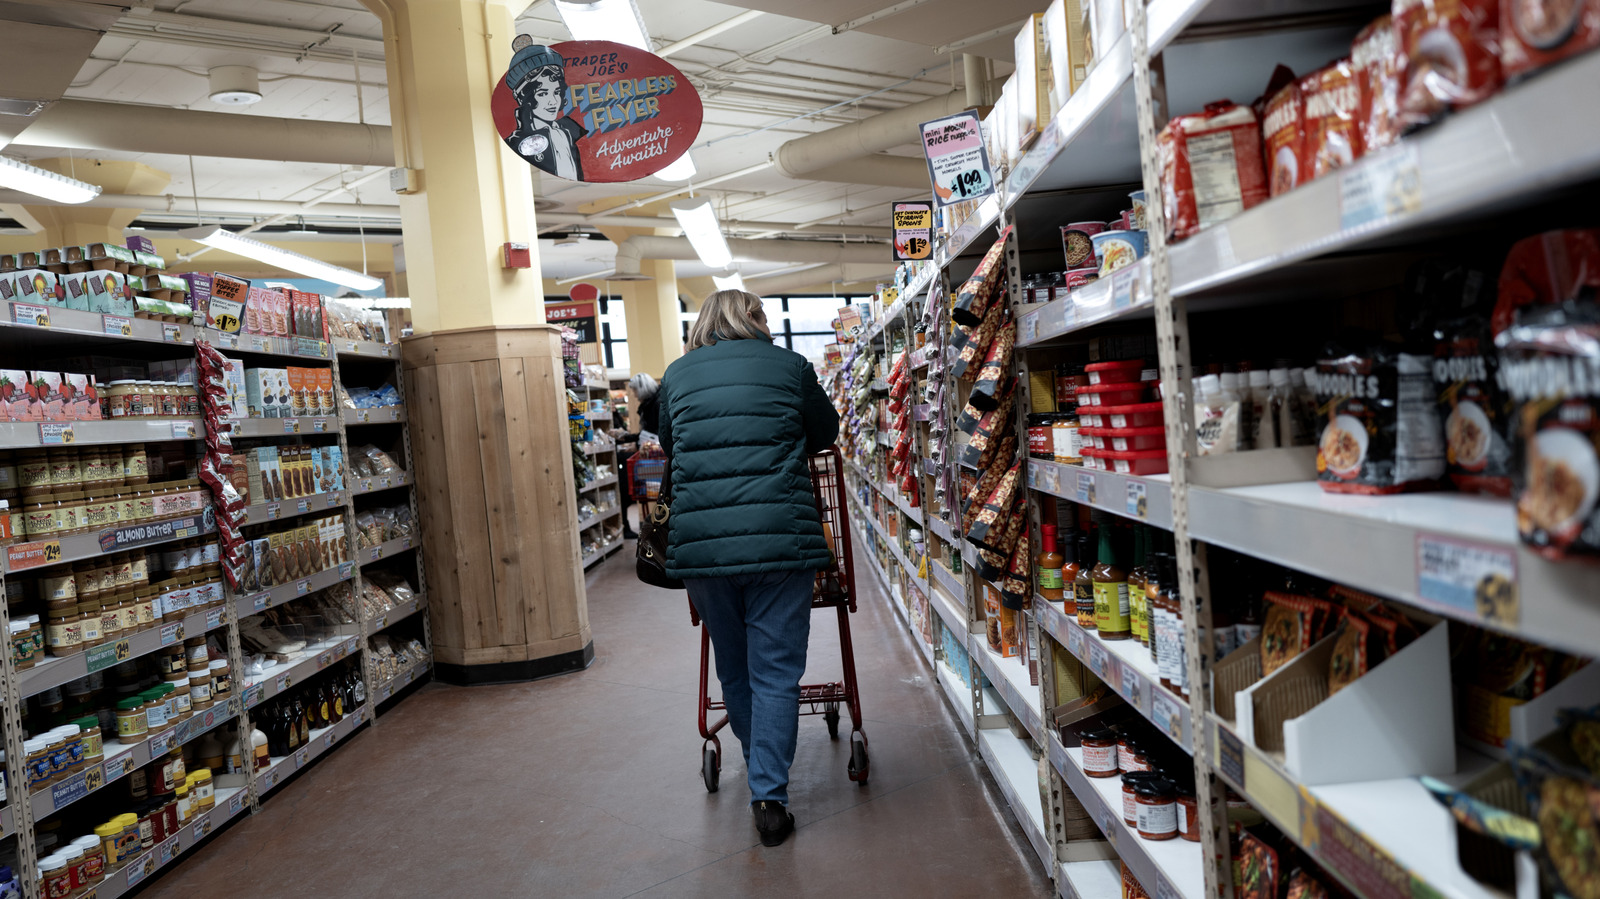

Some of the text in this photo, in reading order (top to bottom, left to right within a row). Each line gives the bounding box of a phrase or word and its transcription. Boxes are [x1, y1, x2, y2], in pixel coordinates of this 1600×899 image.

[563, 53, 618, 68] TRADER
[587, 62, 629, 77] JOE'S
[569, 75, 677, 108] FEARLESS
[591, 97, 660, 130] FLYER
[925, 128, 940, 138] mini
[927, 134, 949, 147] RICE
[596, 126, 674, 158] Adventure
[610, 140, 669, 170] Awaits!
[216, 283, 240, 293] TOFFEE
[216, 290, 235, 298] BITES
[547, 308, 577, 318] JOE'S
[1316, 374, 1379, 398] NOODLES
[9, 549, 43, 560] PEANUT BUTTER
